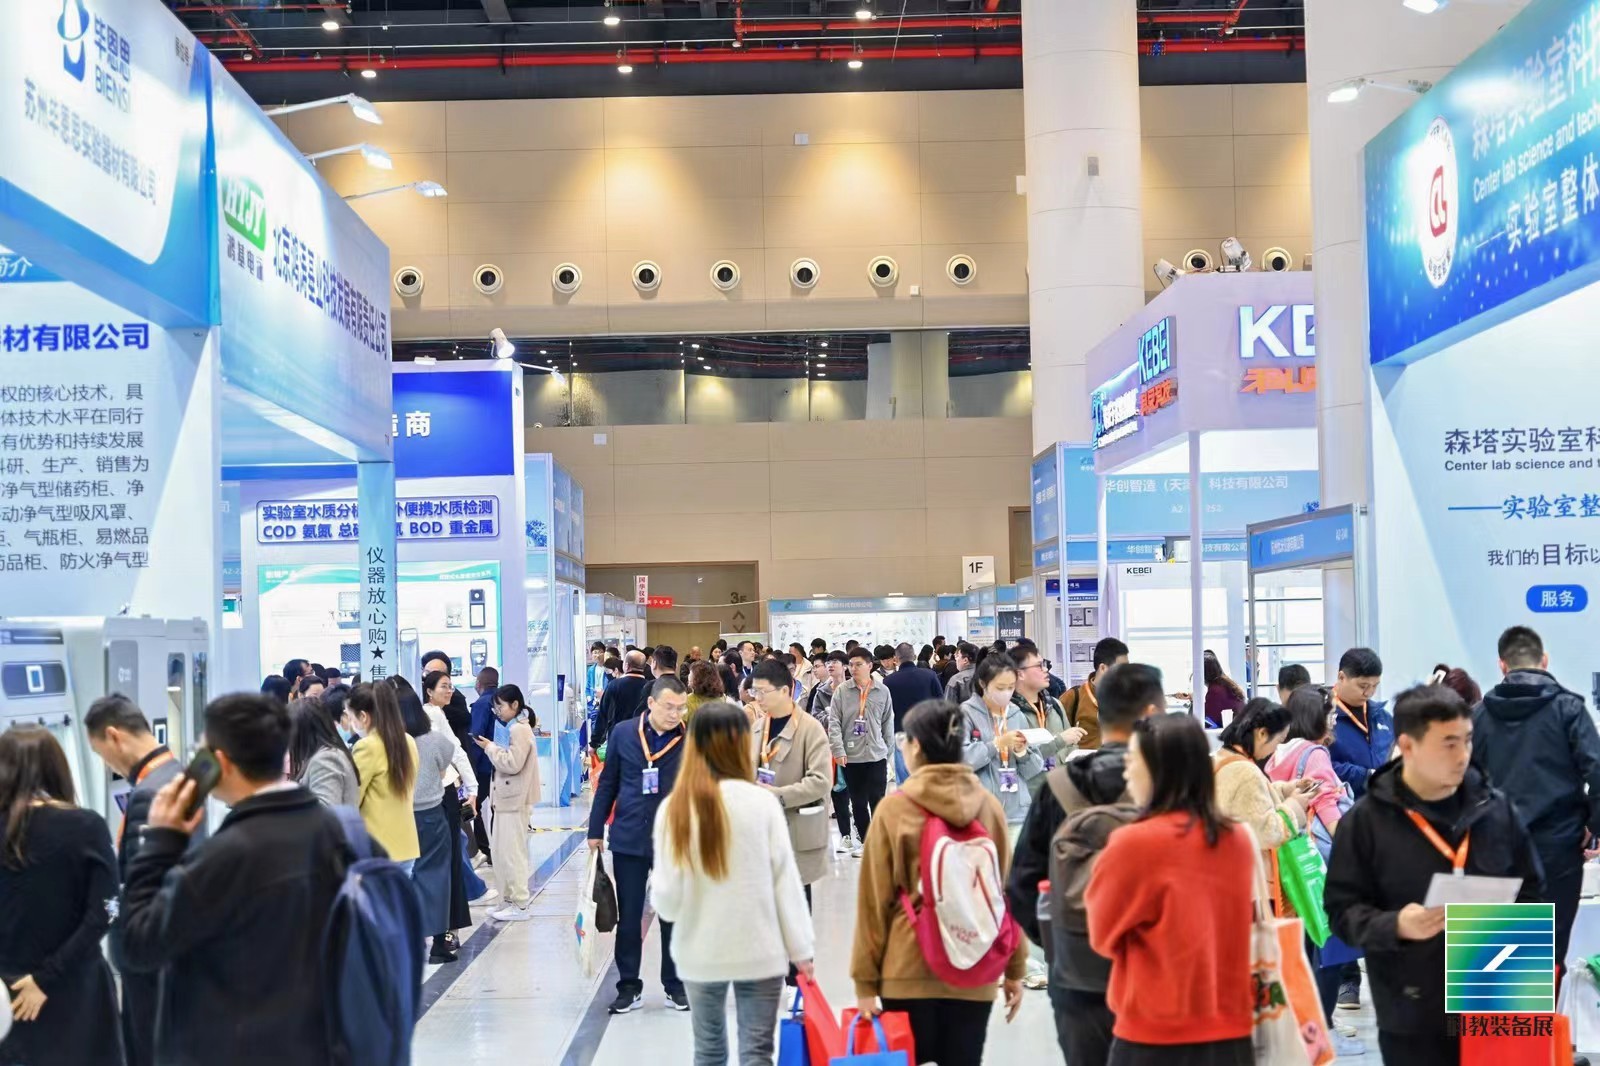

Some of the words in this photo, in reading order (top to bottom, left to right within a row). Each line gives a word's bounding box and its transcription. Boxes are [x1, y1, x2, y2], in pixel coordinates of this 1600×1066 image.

[1502, 155, 1517, 184] lab
[1518, 135, 1554, 175] science
[1555, 113, 1575, 151] and
[1138, 317, 1171, 384] KEBEI
[1445, 459, 1487, 471] Center
[1492, 458, 1511, 470] lab
[1516, 458, 1565, 470] science
[1569, 457, 1593, 469] and
[1209, 476, 1289, 491] 科技有限公司
[263, 525, 296, 538] COD
[302, 523, 332, 539] 氨氮
[409, 521, 443, 535] BOD
[449, 519, 493, 535] 重金属
[0, 551, 149, 571] 品柜、防火净气型
[968, 561, 984, 574] 1F
[730, 591, 746, 604] 3F
[1541, 590, 1575, 607] 服务
